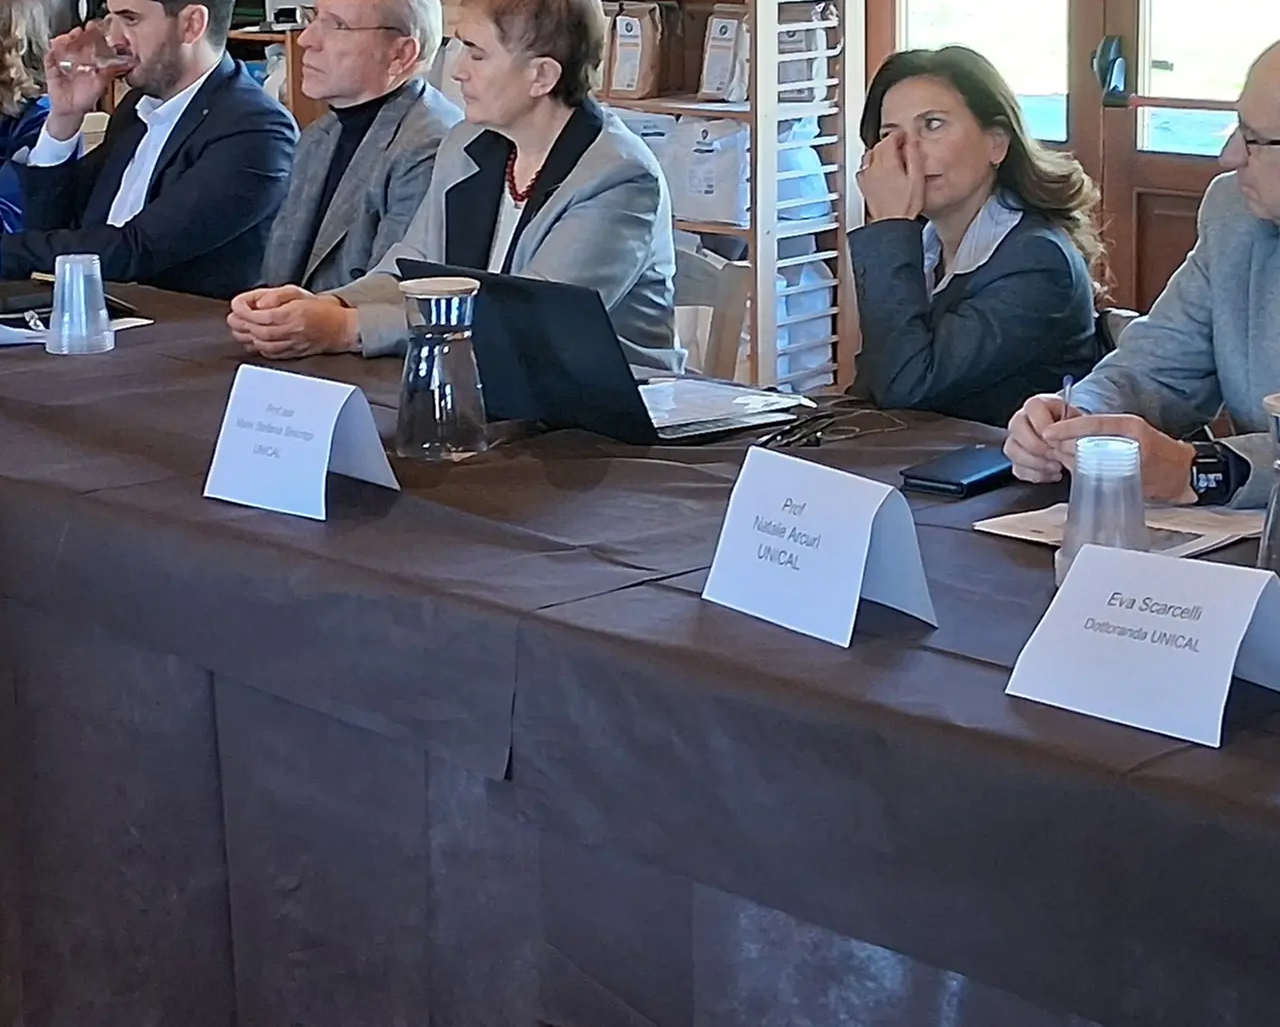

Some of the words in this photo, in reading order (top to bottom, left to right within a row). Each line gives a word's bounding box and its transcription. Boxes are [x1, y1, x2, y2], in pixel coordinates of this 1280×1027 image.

[757, 543, 800, 570] UNICAL
[1107, 591, 1136, 609] Eva
[1138, 596, 1202, 621] Scarcelli
[1084, 617, 1148, 641] Dottoranda
[1150, 630, 1200, 653] UNICAL
